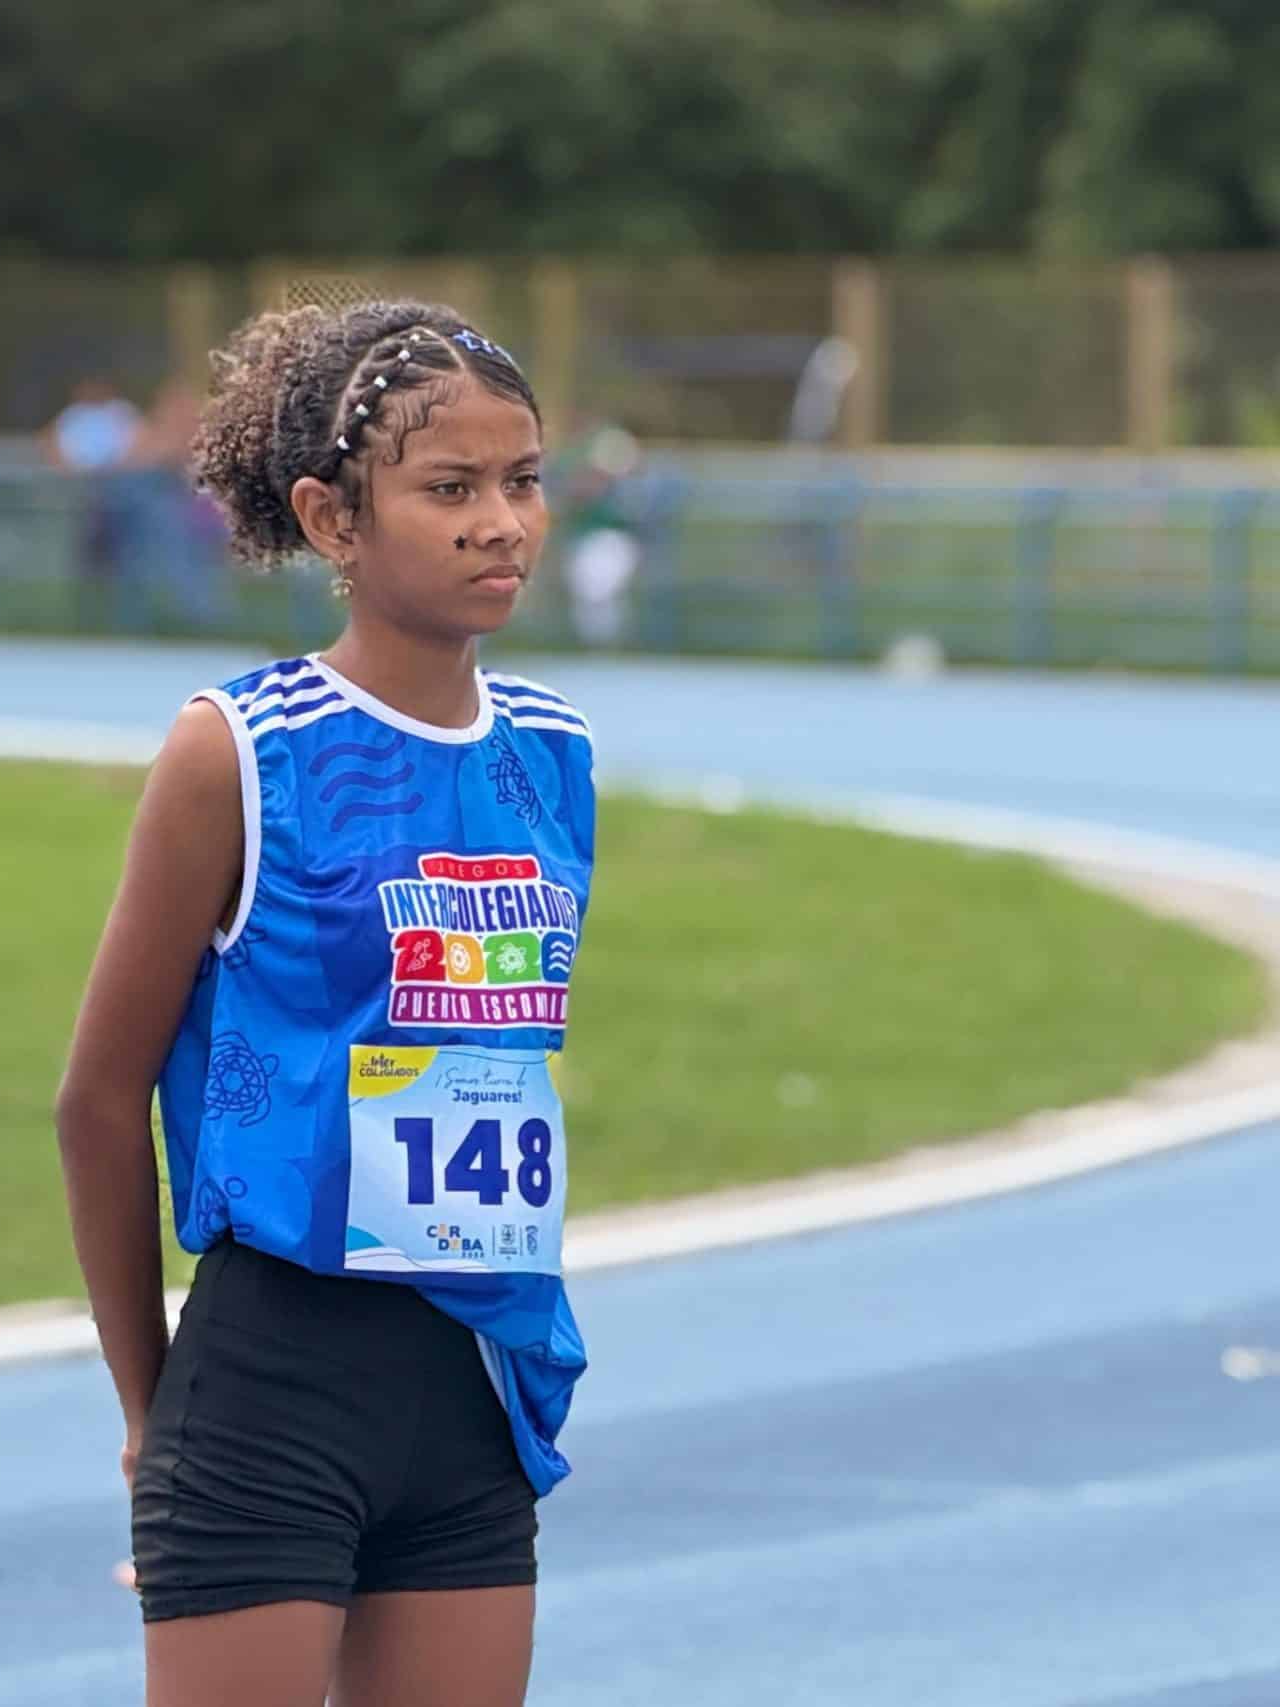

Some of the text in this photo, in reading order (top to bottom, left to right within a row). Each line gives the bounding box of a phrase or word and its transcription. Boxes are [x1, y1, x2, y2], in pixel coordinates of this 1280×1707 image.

[435, 861, 526, 878] JUEGOS
[395, 991, 473, 1020] PUERTO
[451, 1087, 523, 1106] Jaguares!
[394, 1117, 552, 1208] 148
